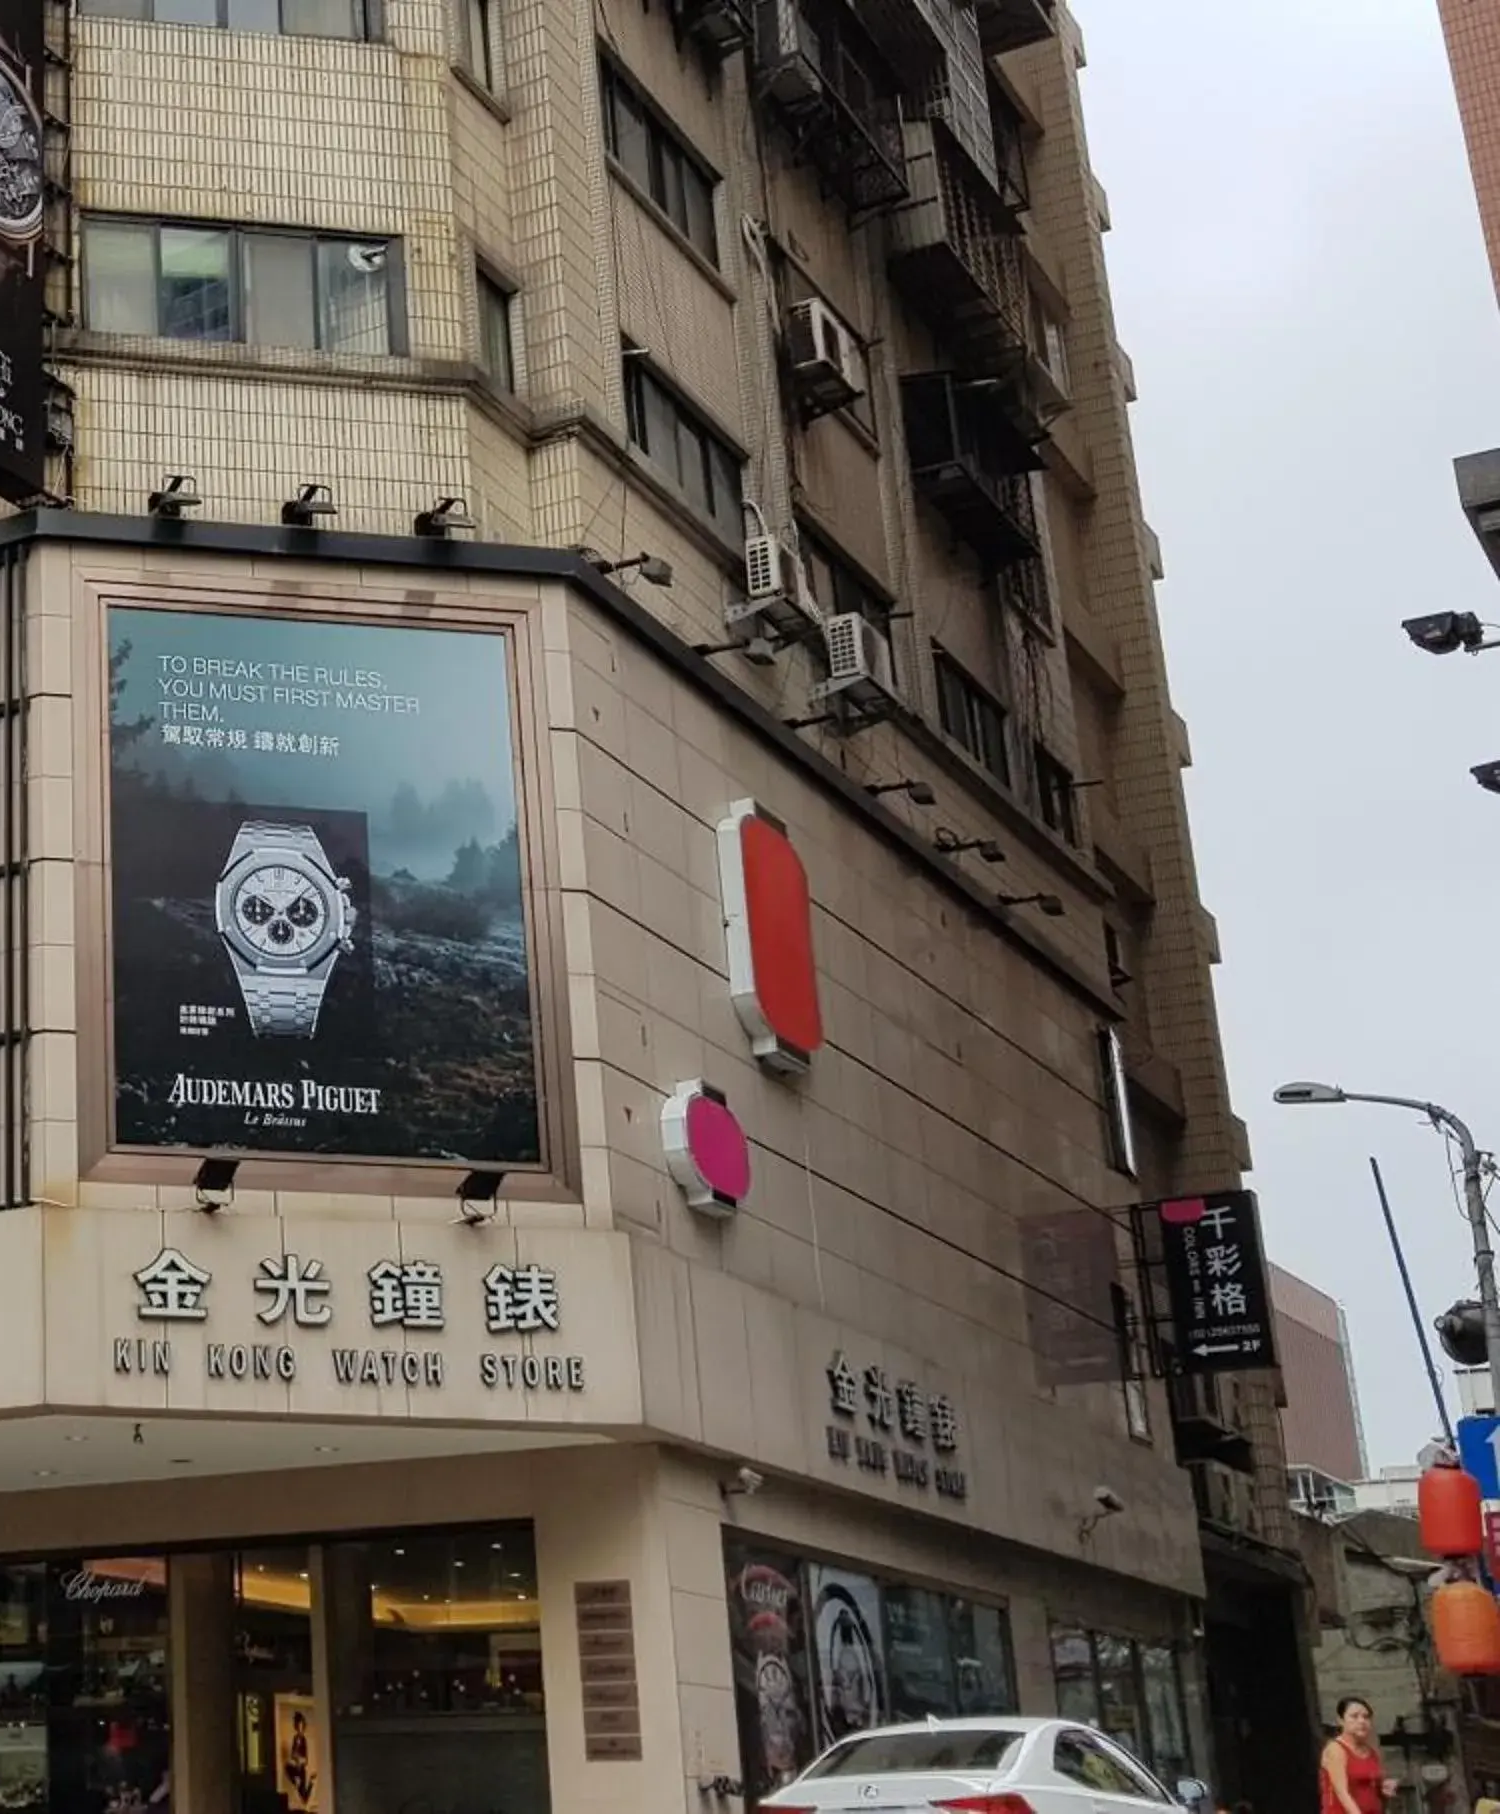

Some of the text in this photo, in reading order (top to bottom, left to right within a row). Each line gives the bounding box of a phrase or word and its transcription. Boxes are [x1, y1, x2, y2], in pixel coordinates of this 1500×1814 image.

[157, 655, 187, 673] TO
[193, 658, 263, 680] BREAK
[268, 664, 309, 683] THE
[157, 679, 420, 714] YOU MUST FIRST MASTER
[157, 701, 224, 723] THEM.
[167, 1073, 381, 1114] AUDEMARS PIGUET
[1200, 1205, 1247, 1317] 千彩格
[133, 1247, 561, 1335] 金光鐘錶
[113, 1337, 586, 1392] KIN KONG WATCH STORE
[60, 1568, 150, 1604] Chopard
